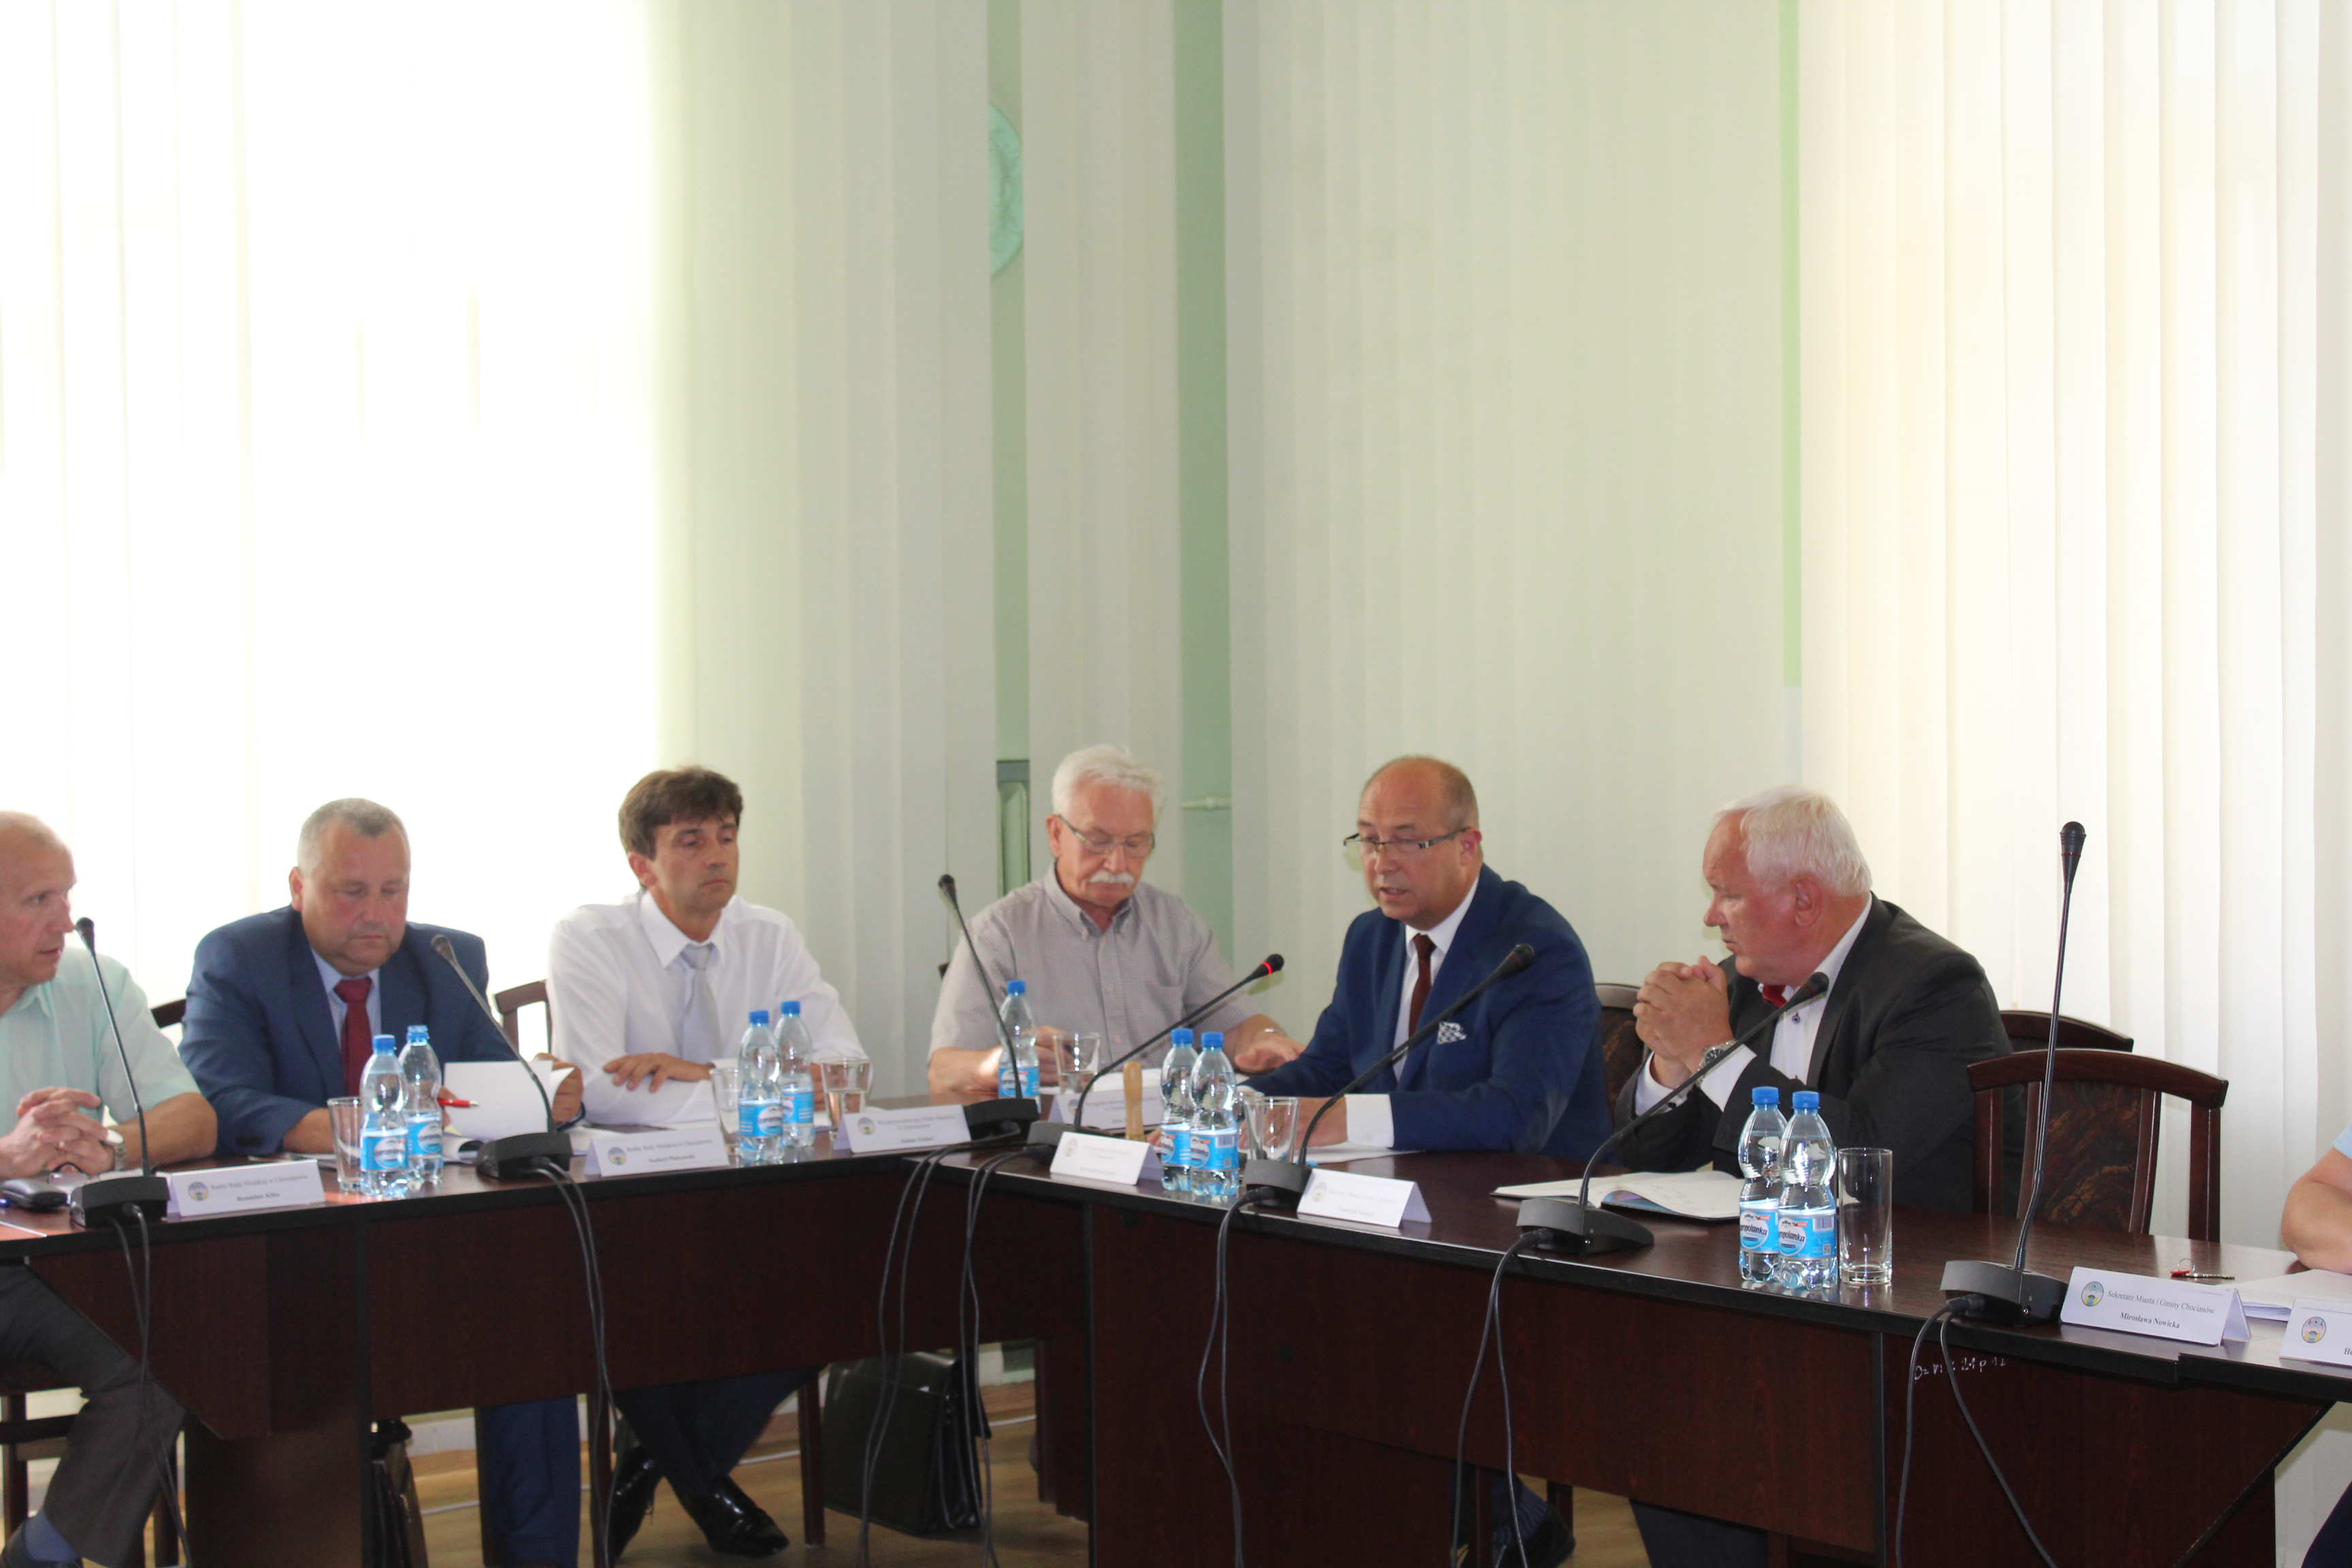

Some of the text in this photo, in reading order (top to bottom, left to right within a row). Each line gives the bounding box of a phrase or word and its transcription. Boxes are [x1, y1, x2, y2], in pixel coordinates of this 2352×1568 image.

[2107, 1290, 2134, 1301] Sekretarz
[2135, 1295, 2155, 1305] Miasta
[2159, 1299, 2180, 1309] Gminy
[2180, 1303, 2215, 1314] Chocianów
[2153, 1318, 2180, 1328] Nowicka
